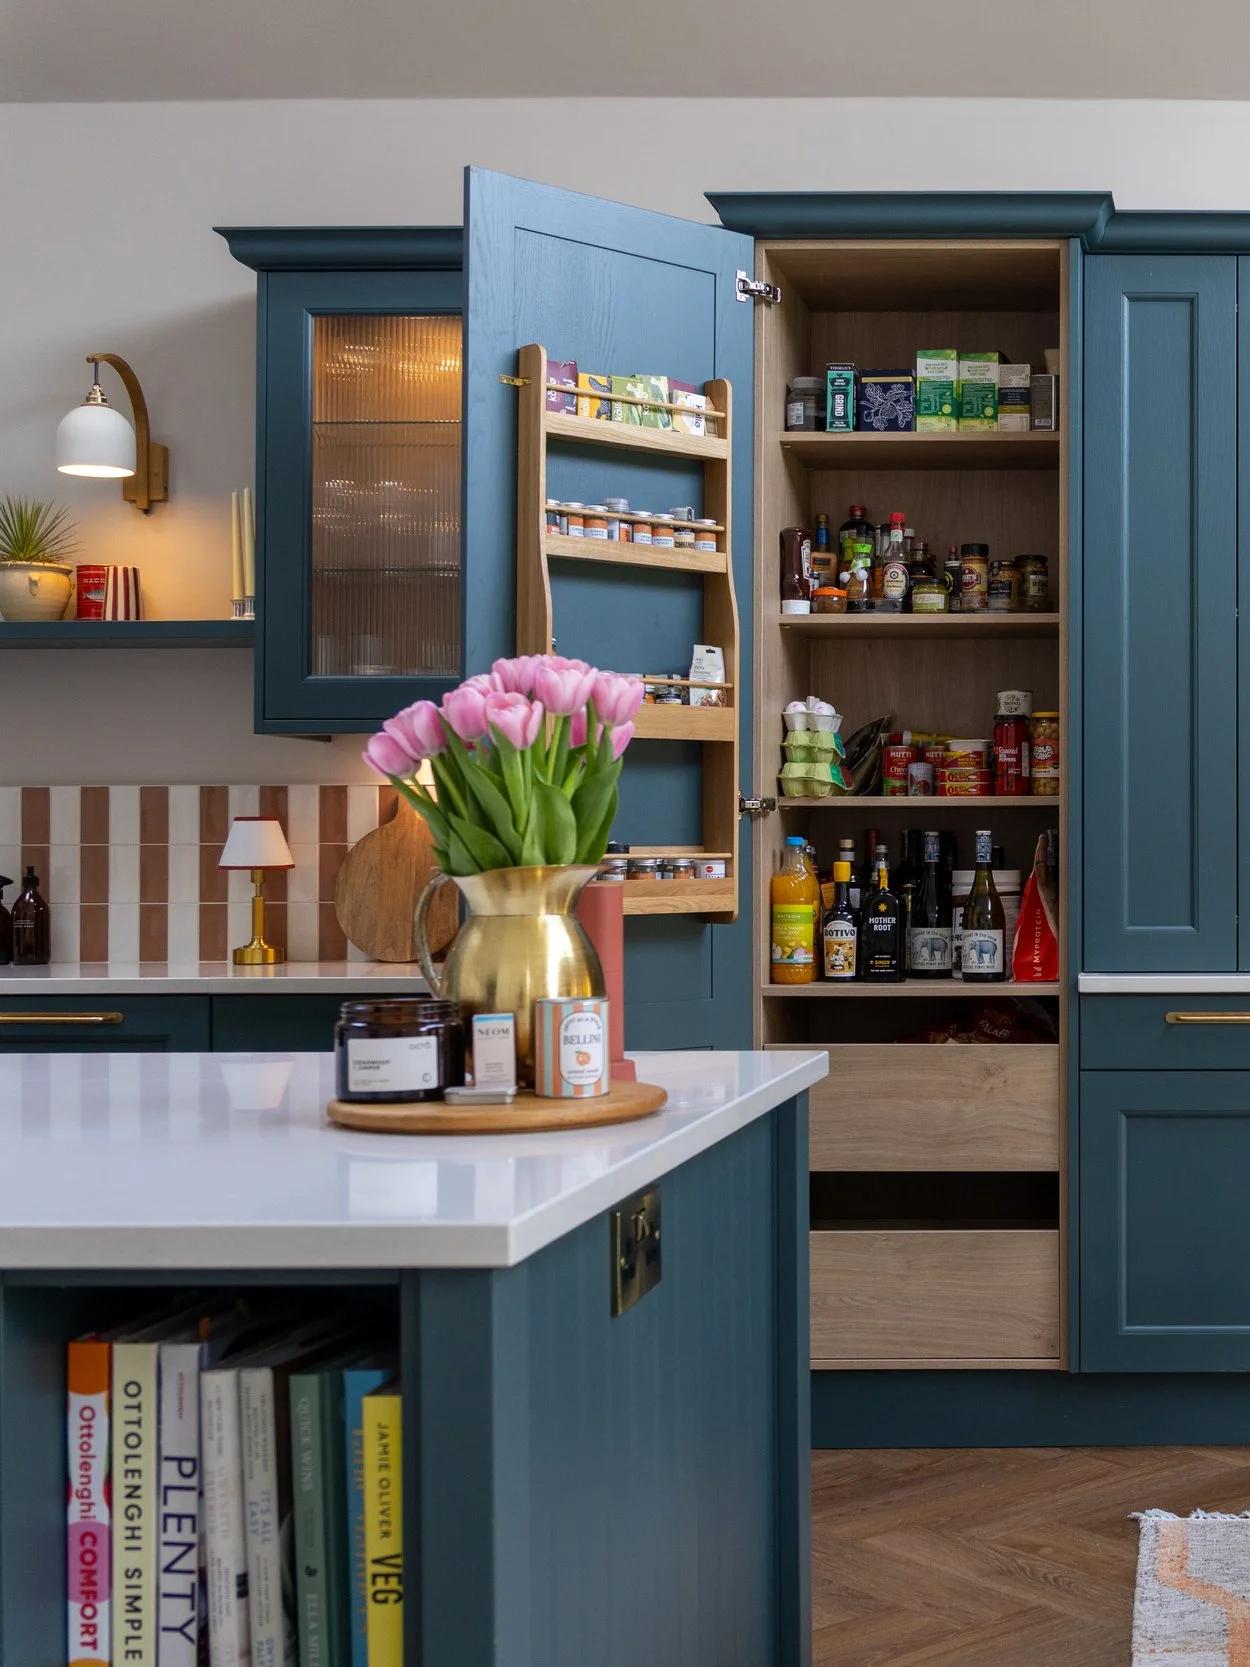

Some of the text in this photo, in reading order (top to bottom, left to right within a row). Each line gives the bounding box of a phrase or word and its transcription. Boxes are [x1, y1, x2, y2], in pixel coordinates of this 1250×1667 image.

[834, 394, 845, 417] GRIND
[824, 929, 856, 938] BOTIVO
[1034, 908, 1042, 964] MYPROTEIN
[477, 1028, 510, 1036] NEOM
[296, 1396, 313, 1447] QUICK
[299, 1450, 315, 1492] WINS
[75, 1405, 99, 1652] Ottolenghi COMFORT
[123, 1380, 144, 1661] OTTOLENGHI SIMPLE
[248, 1500, 260, 1537] EASY
[371, 1422, 404, 1606] JAMIE OLIVER VEG
[161, 1455, 198, 1645] PLENTY
[305, 1593, 320, 1631] ELLA
